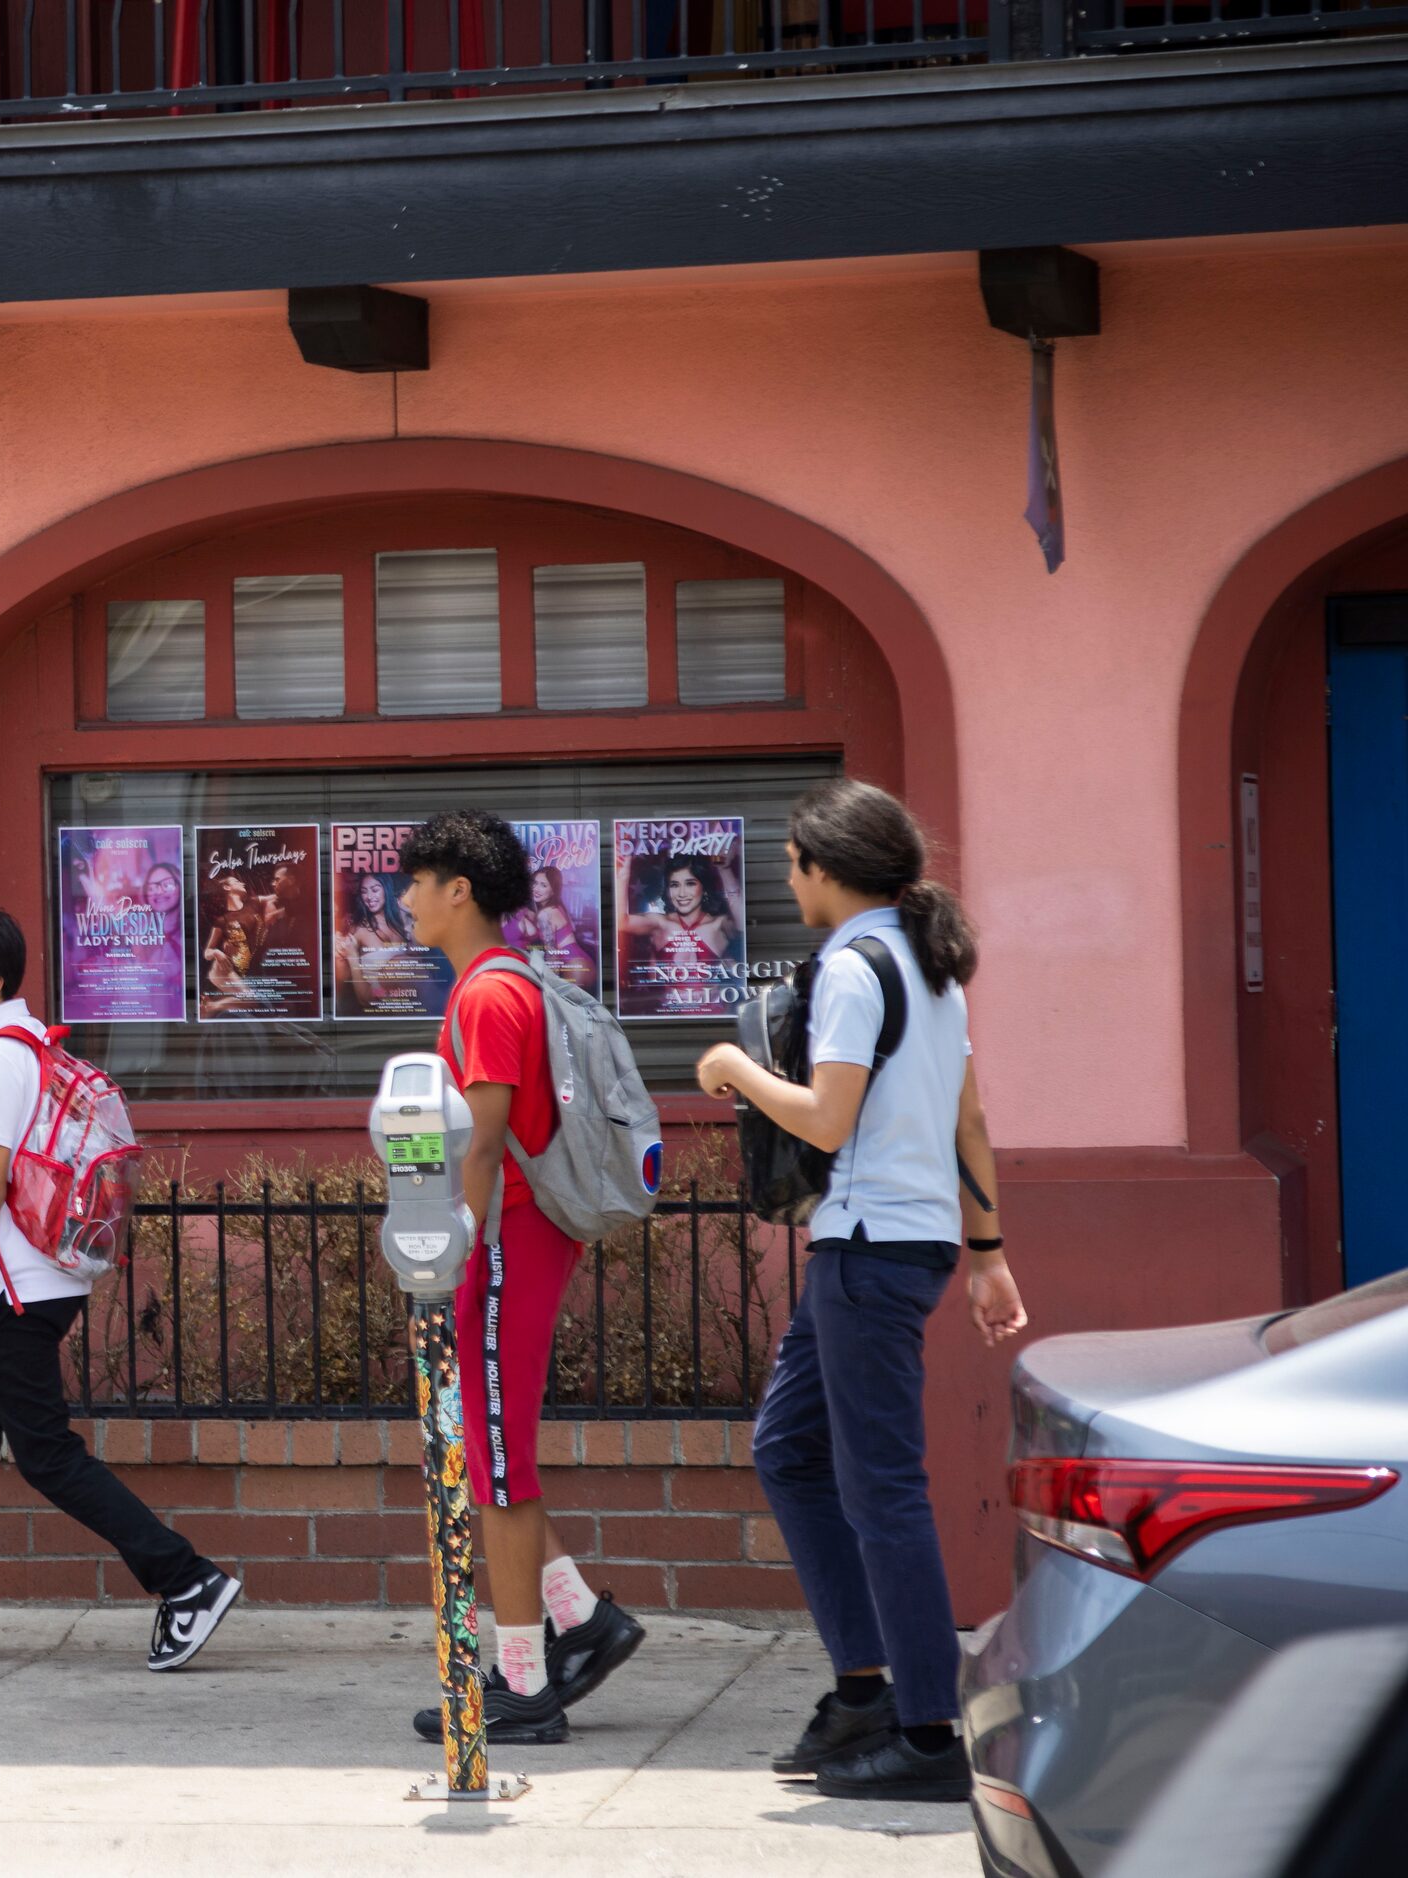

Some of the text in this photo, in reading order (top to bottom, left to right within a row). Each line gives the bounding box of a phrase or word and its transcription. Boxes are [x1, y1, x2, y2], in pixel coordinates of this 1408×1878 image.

[209, 842, 308, 879] Salsa Thursdays
[620, 840, 664, 856] DAY
[75, 912, 166, 936] WEDNESDAY
[117, 896, 153, 921] Down
[76, 935, 166, 947] LADY'S NIGHT
[652, 966, 690, 983] NO
[490, 1242, 503, 1287] OLLISTER
[485, 1295, 500, 1351] HOLLISTER
[486, 1360, 501, 1416] HOLLISTER
[490, 1425, 505, 1479] HOLLISTER
